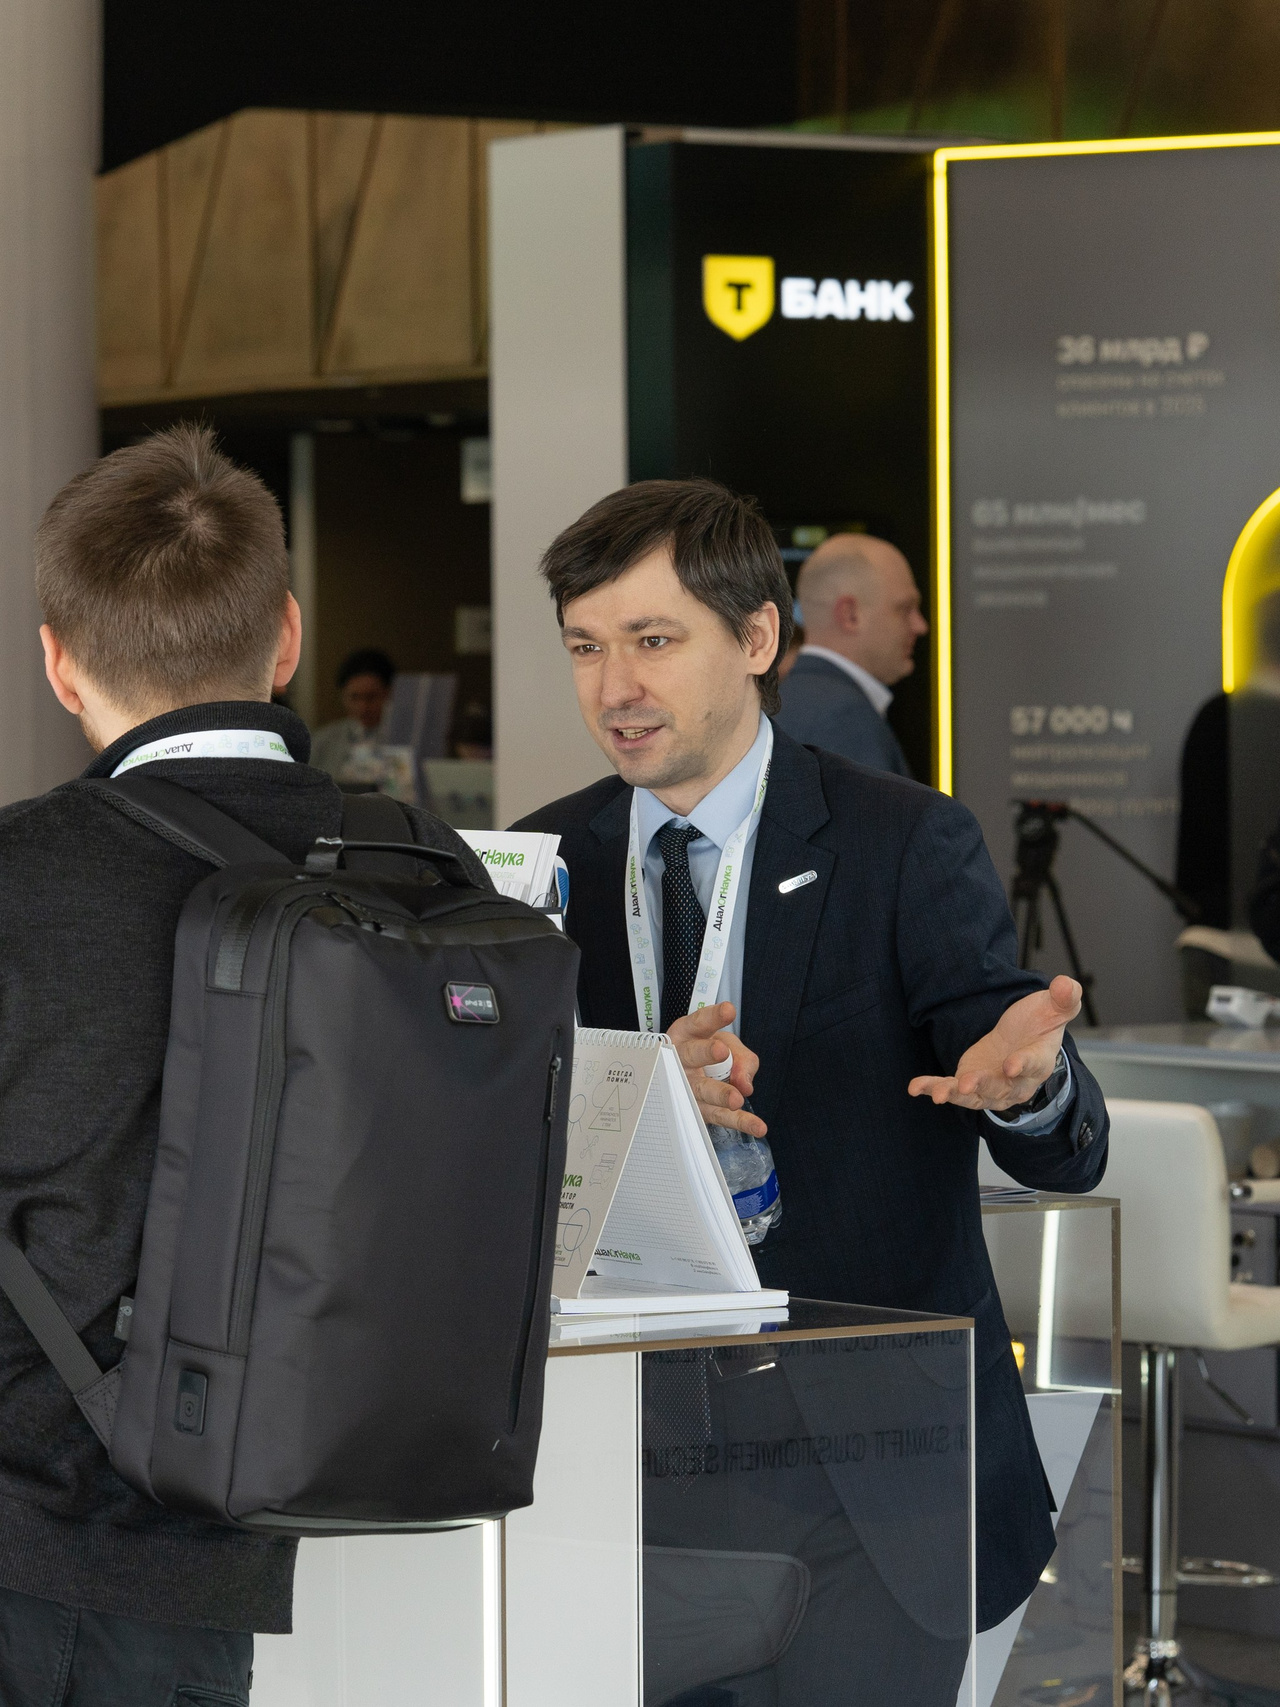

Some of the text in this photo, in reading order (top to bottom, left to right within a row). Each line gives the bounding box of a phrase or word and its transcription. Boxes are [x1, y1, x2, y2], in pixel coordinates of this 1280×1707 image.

[781, 277, 914, 321] БАНК
[1049, 706, 1109, 735] 000
[643, 986, 654, 1033] лОгНаука
[559, 1191, 577, 1200] АТОР
